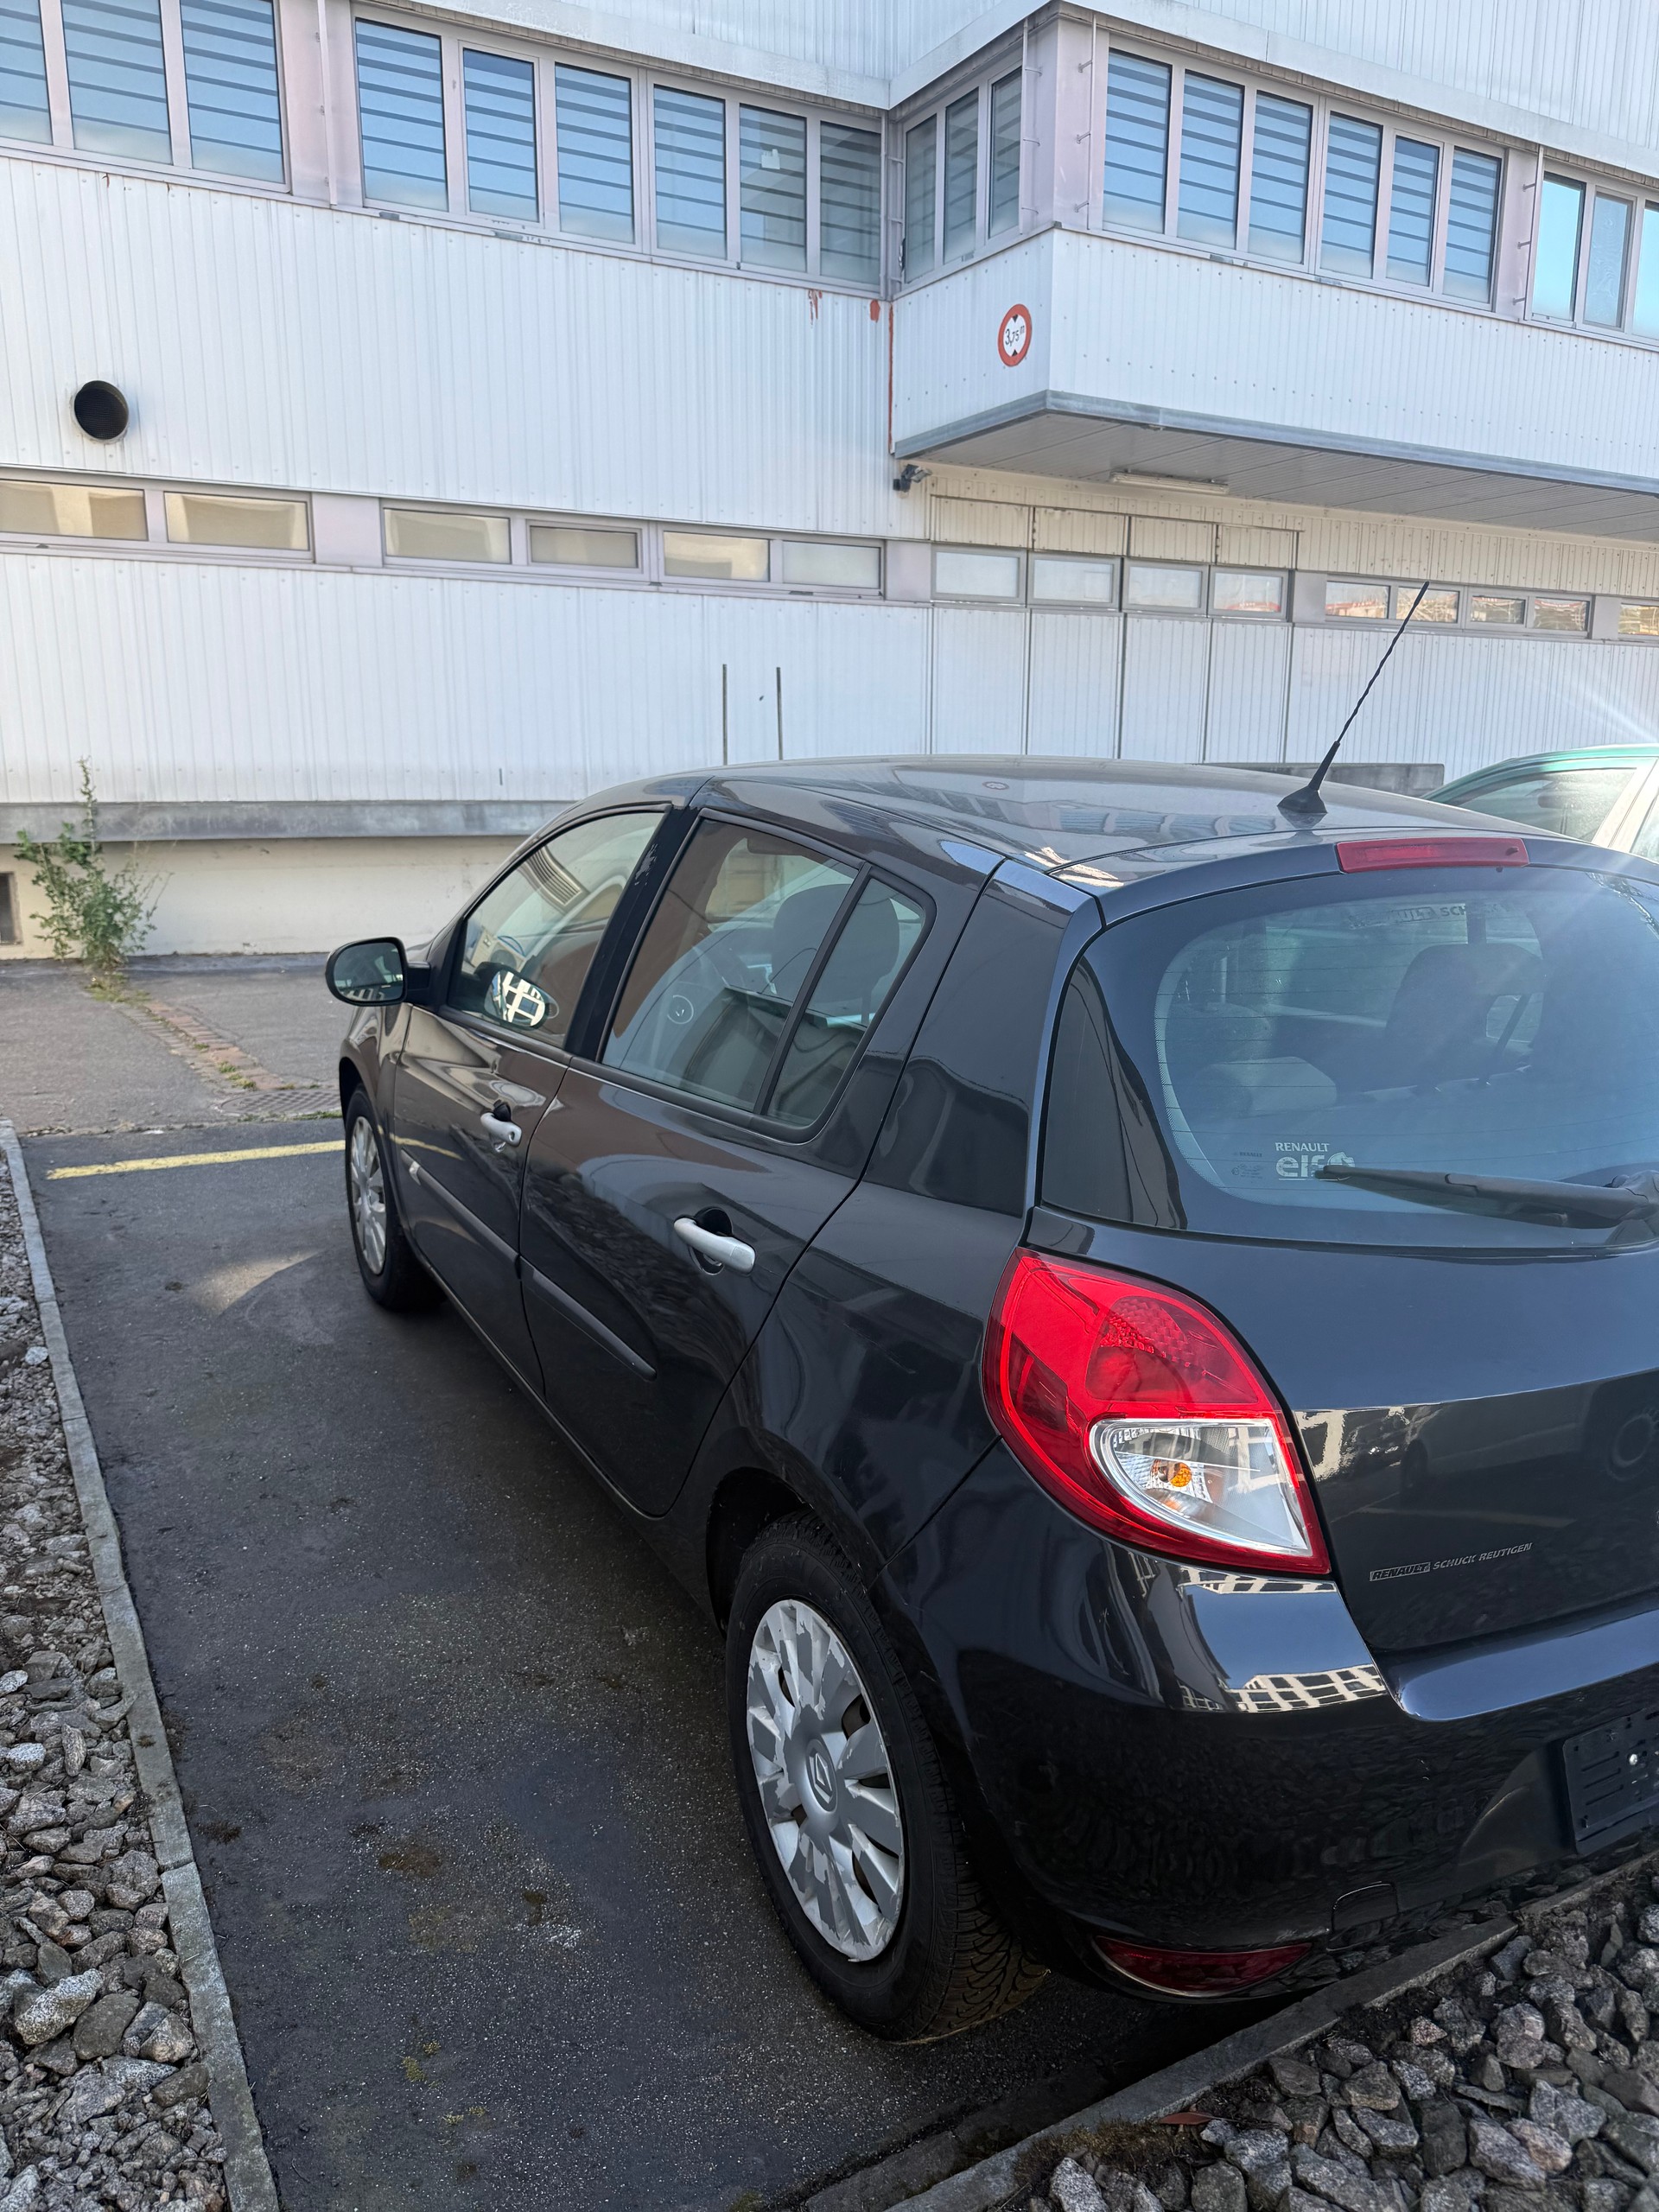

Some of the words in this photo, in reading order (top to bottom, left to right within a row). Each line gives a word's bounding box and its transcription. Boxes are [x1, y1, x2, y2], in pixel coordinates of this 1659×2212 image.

[1274, 1142, 1331, 1153] RENAULT
[1371, 1565, 1427, 1580] RENAULT
[1433, 1554, 1478, 1570] SCHUCK
[1478, 1541, 1534, 1561] REUTIGEN
